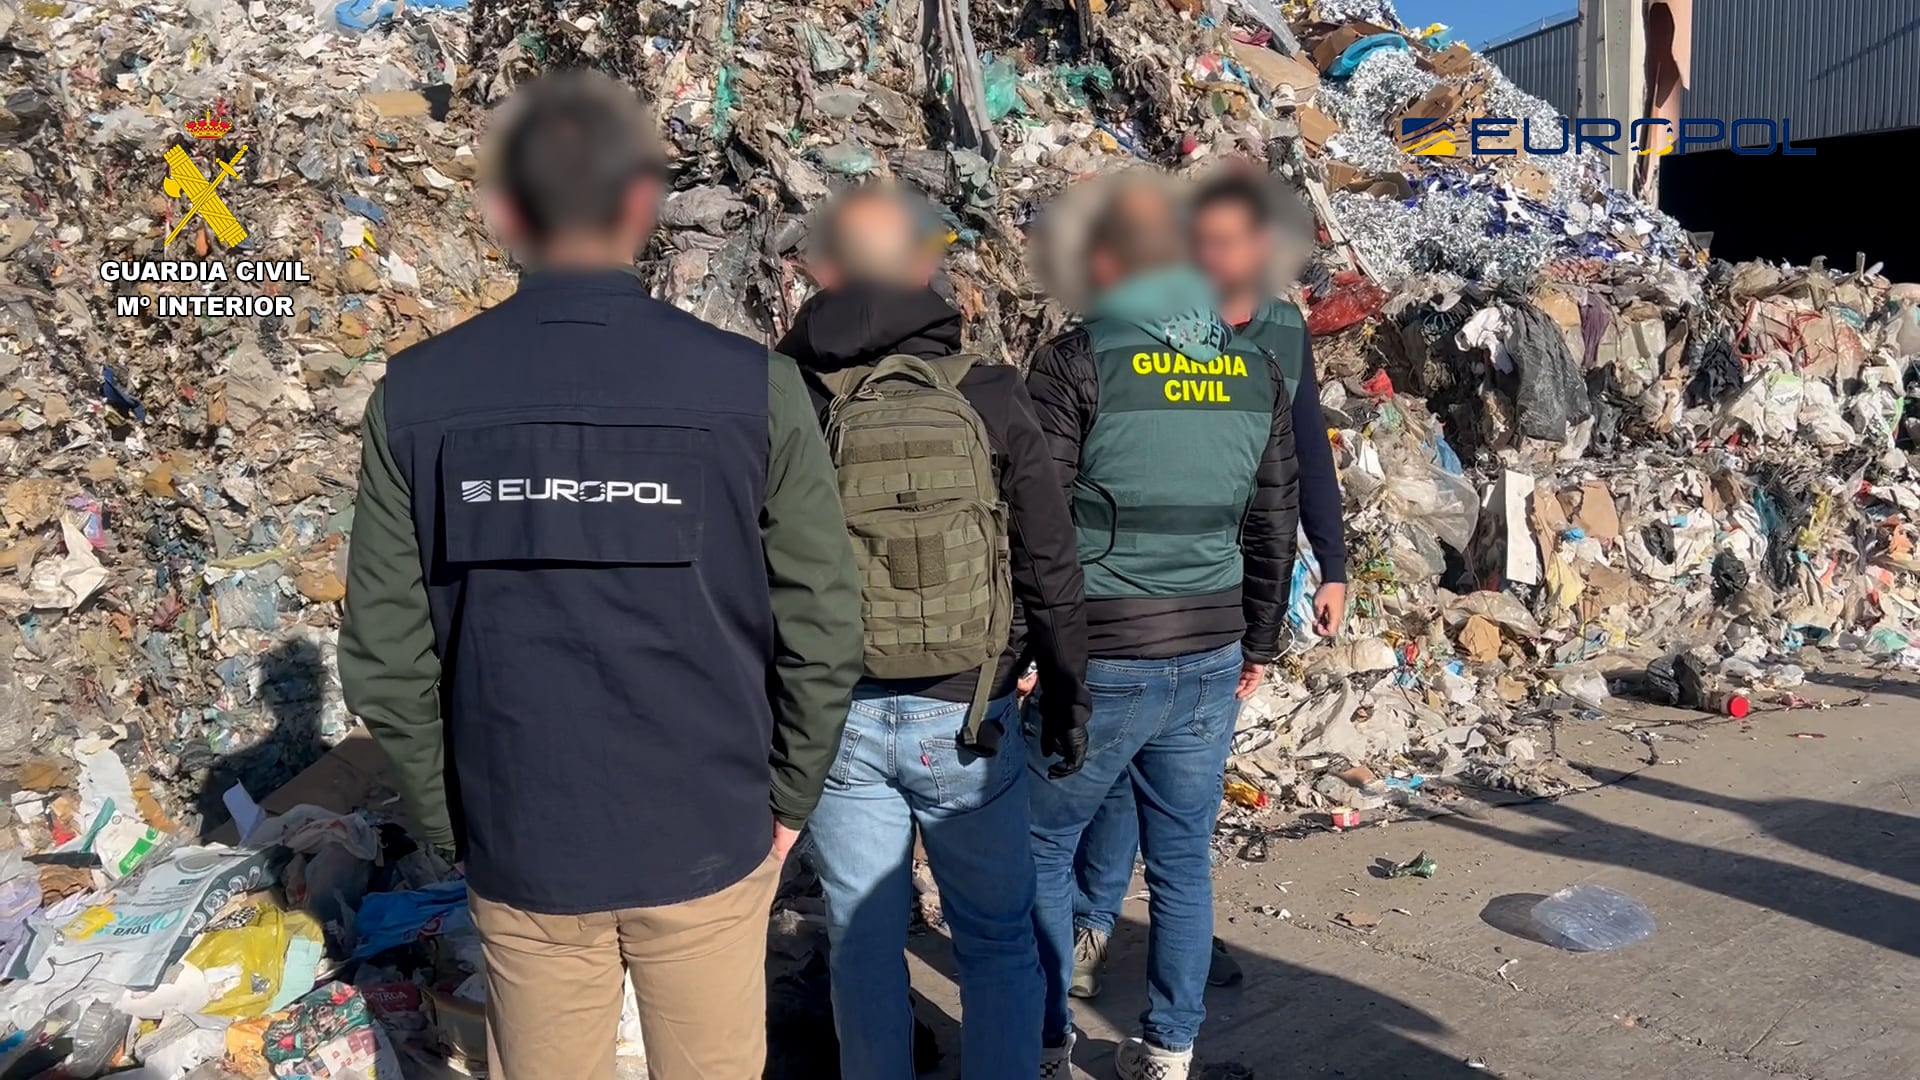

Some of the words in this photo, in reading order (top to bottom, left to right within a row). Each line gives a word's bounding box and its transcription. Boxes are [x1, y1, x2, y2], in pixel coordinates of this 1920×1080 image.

[1132, 352, 1249, 377] GUARDIA
[1164, 379, 1232, 402] CIVIL
[497, 477, 683, 506] EUROPOL
